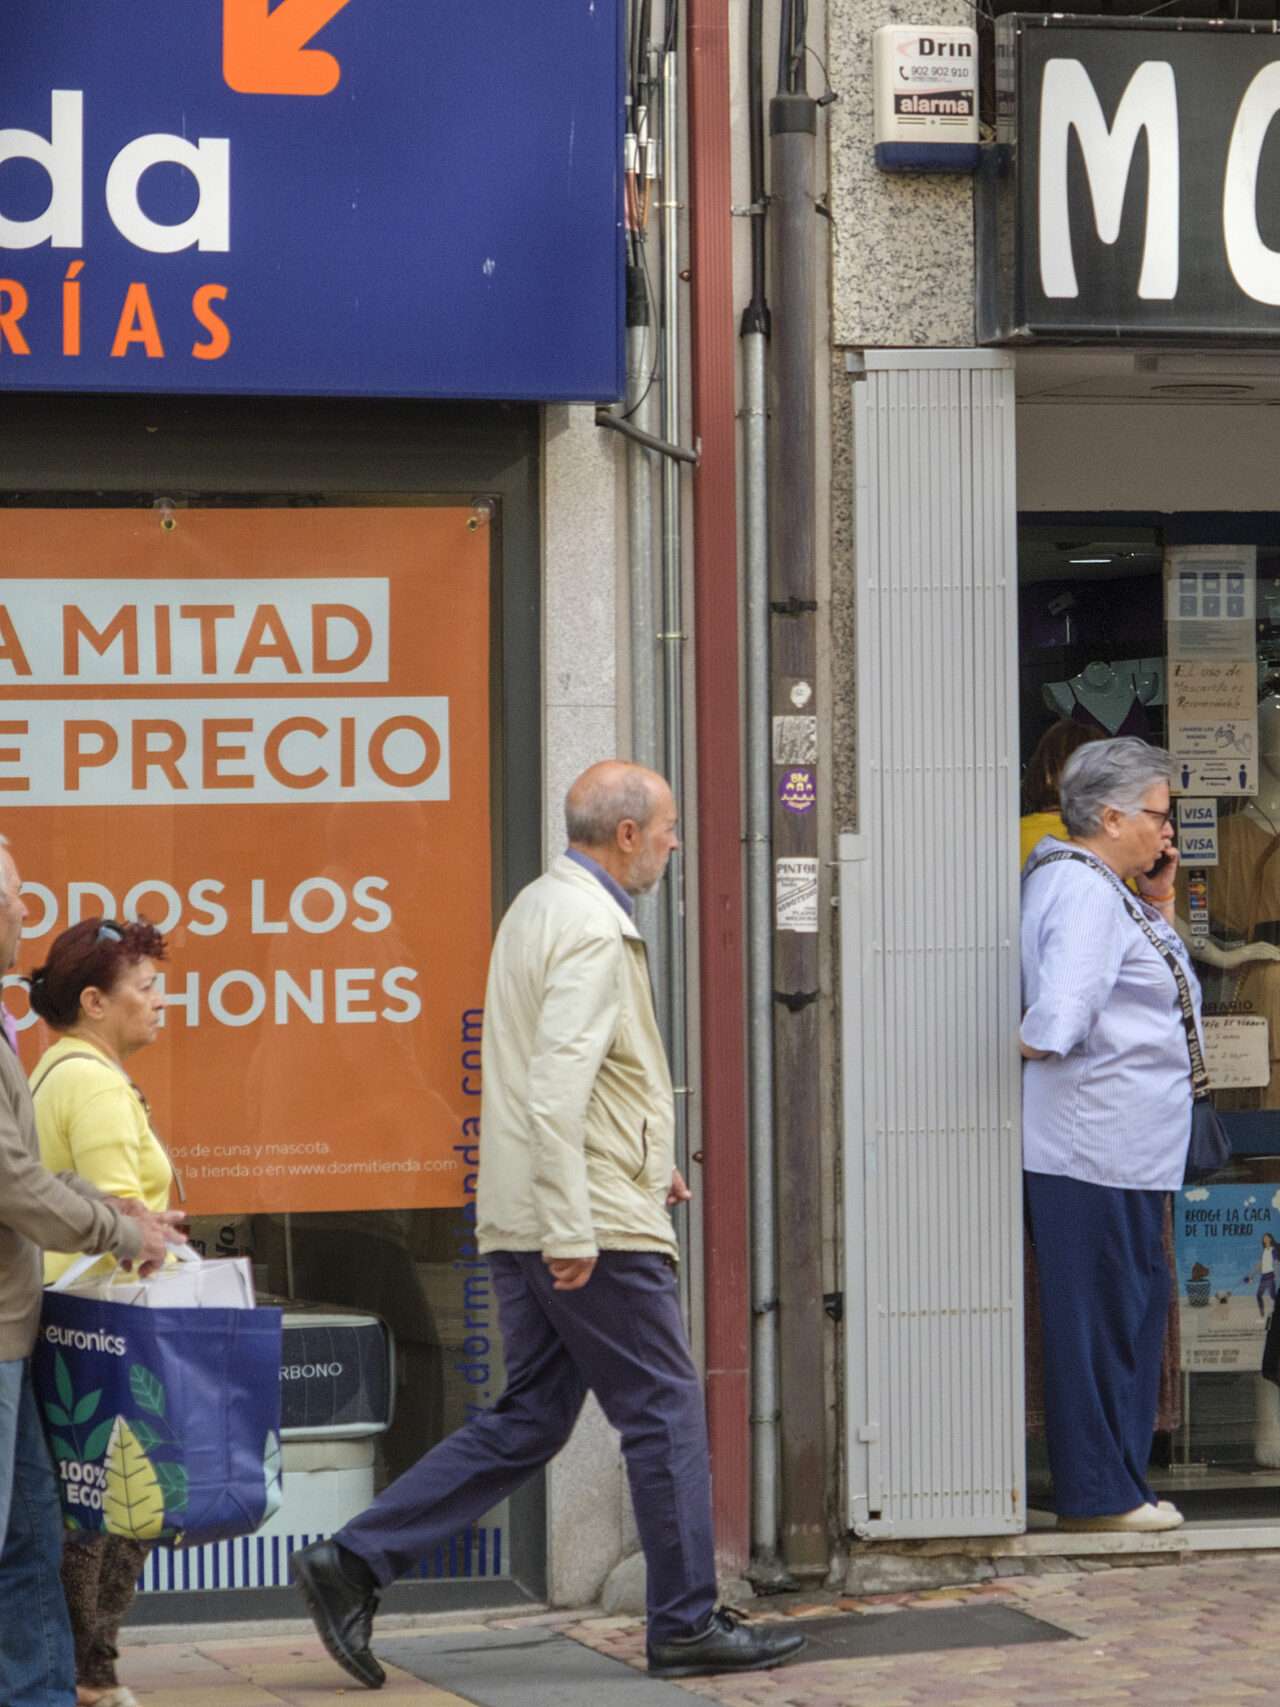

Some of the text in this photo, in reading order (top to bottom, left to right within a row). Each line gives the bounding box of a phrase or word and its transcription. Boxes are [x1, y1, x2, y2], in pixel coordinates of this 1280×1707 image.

[900, 95, 970, 114] alarma
[0, 90, 230, 253] da
[0, 260, 231, 360] RÍAS
[62, 603, 373, 676] MITAD
[63, 715, 441, 791] PRECIO
[1184, 807, 1213, 820] VISA
[1185, 838, 1215, 851] VISA
[251, 876, 393, 935] LOS
[1173, 963, 1193, 1018] BIMBA
[191, 1143, 210, 1157] de
[214, 1144, 250, 1156] cuna
[254, 1143, 264, 1160] y
[202, 1162, 249, 1177] tienda
[288, 1157, 457, 1175] www.dormitienda.com
[1185, 1207, 1271, 1222] RECOGE LA CACA
[1185, 1223, 1253, 1237] DE TU PERRO
[46, 1325, 126, 1357] euronics
[59, 1460, 106, 1489] 100%
